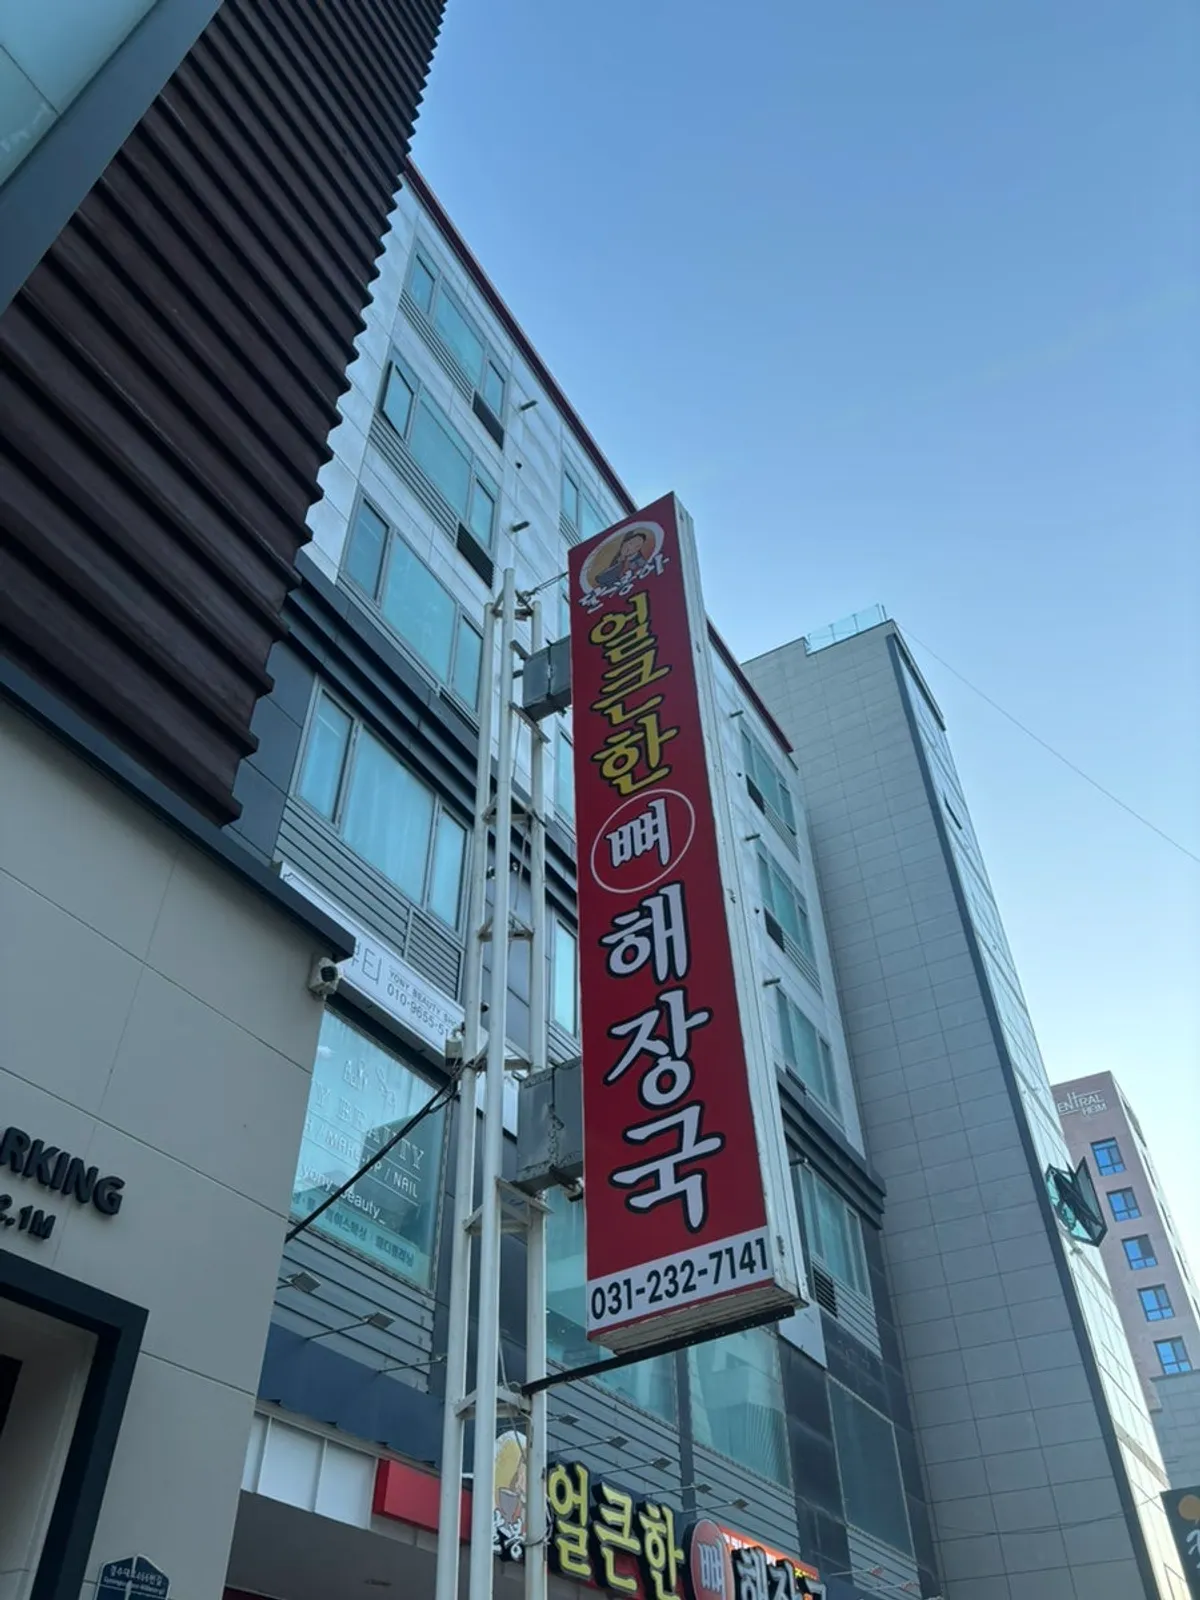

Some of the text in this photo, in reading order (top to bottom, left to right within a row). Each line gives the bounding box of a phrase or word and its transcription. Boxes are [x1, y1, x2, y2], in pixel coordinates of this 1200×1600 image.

[589, 591, 680, 798] 얼큰한
[605, 797, 673, 868] 뼈
[599, 881, 726, 1234] 해장국
[1057, 1090, 1105, 1112] ENTRAL
[393, 1170, 418, 1199] NAIL
[591, 1236, 769, 1321] 031-232-7141
[548, 1460, 685, 1600] 얼큰한
